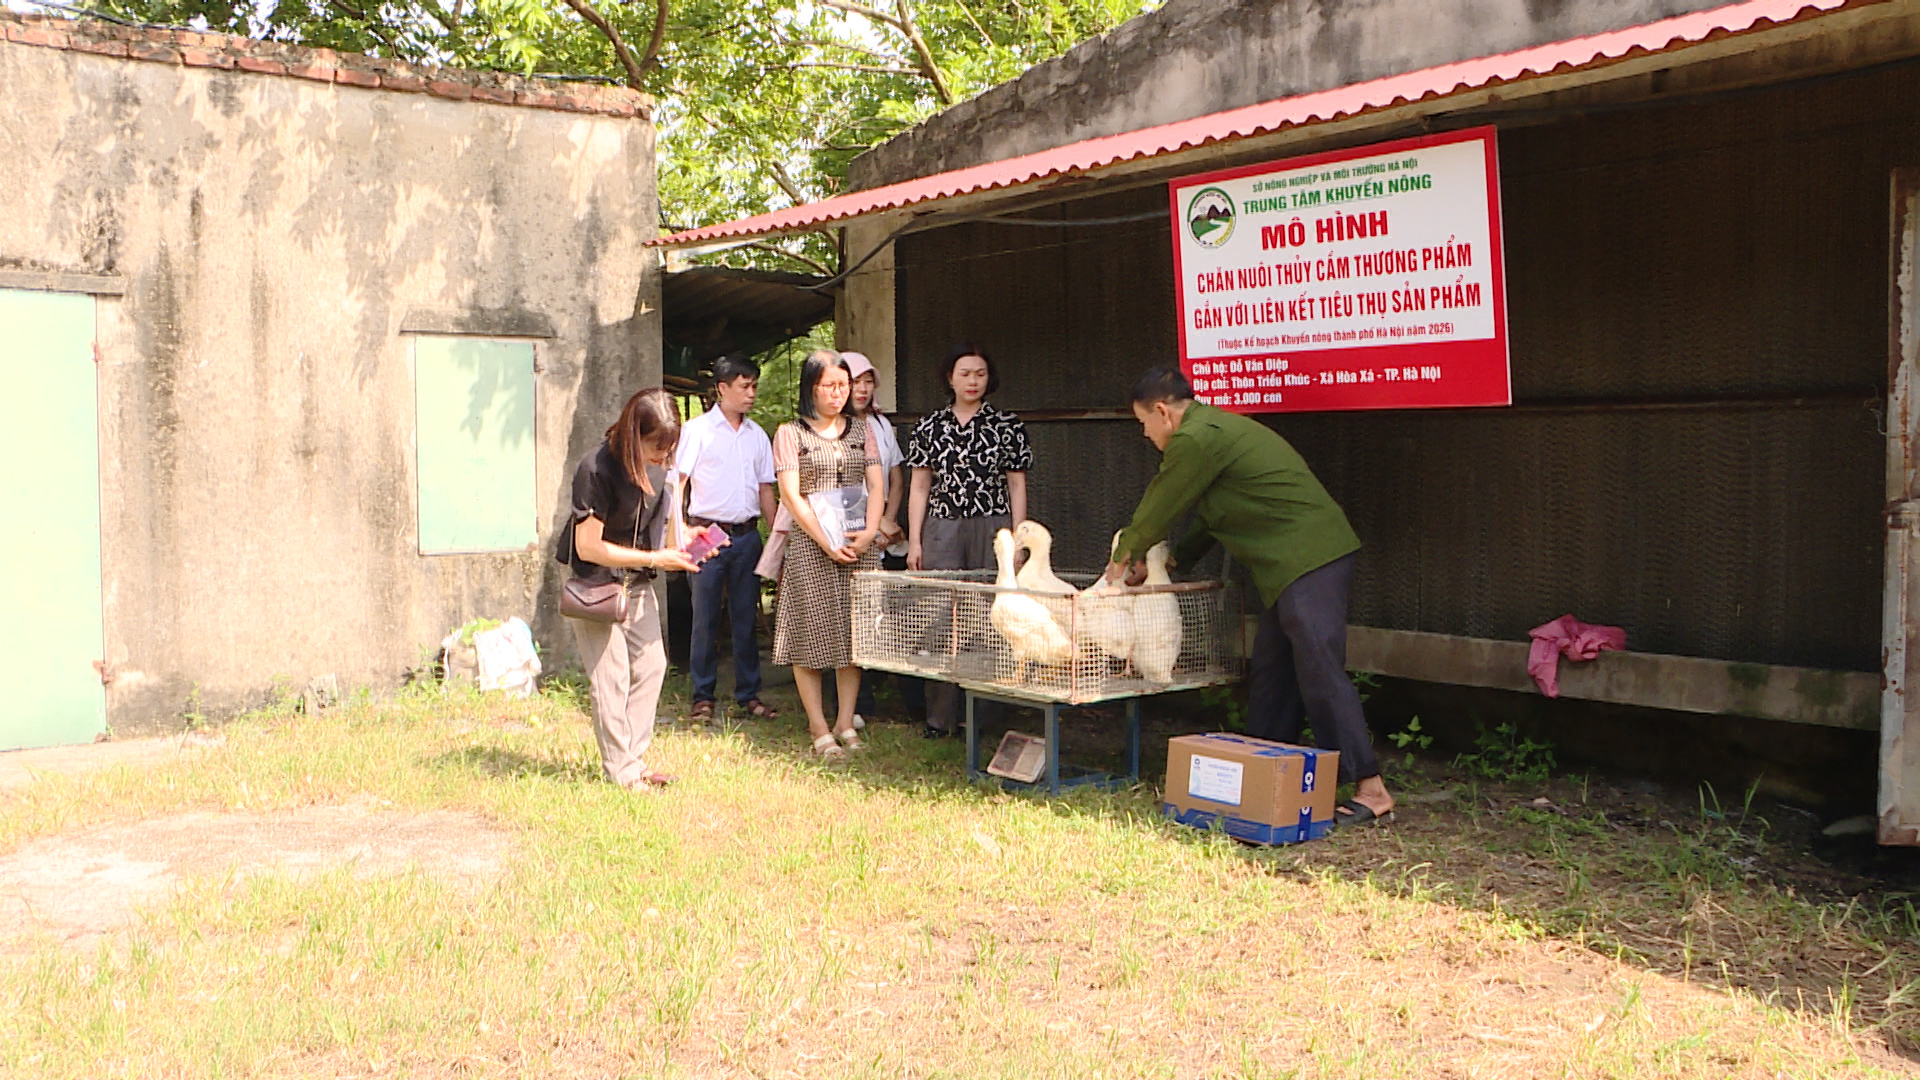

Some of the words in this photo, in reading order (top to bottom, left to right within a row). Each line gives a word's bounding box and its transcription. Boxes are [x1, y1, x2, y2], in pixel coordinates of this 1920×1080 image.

[1243, 195, 1287, 214] TRUNG
[1291, 188, 1321, 207] TÂM
[1326, 178, 1384, 203] KHUYẾN
[1388, 174, 1432, 193] NÔNG
[1261, 216, 1305, 250] MÔ
[1316, 210, 1388, 244] HÌNH
[1198, 267, 1234, 294] CHĂN
[1238, 261, 1272, 288] NUÔI
[1276, 254, 1311, 286] THỦY
[1354, 248, 1418, 277] THƯƠNG
[1422, 234, 1472, 270] PHẨM
[1194, 300, 1222, 329] GẮN
[1226, 300, 1248, 327] VỚI
[1252, 297, 1284, 324] LIÊN
[1289, 290, 1314, 321] KẾT
[1319, 290, 1352, 318] TIÊU
[1357, 292, 1386, 319] THỤ
[1392, 280, 1426, 313] SẢN
[1430, 274, 1480, 310] PHẨM
[1234, 392, 1261, 405] 3.000
